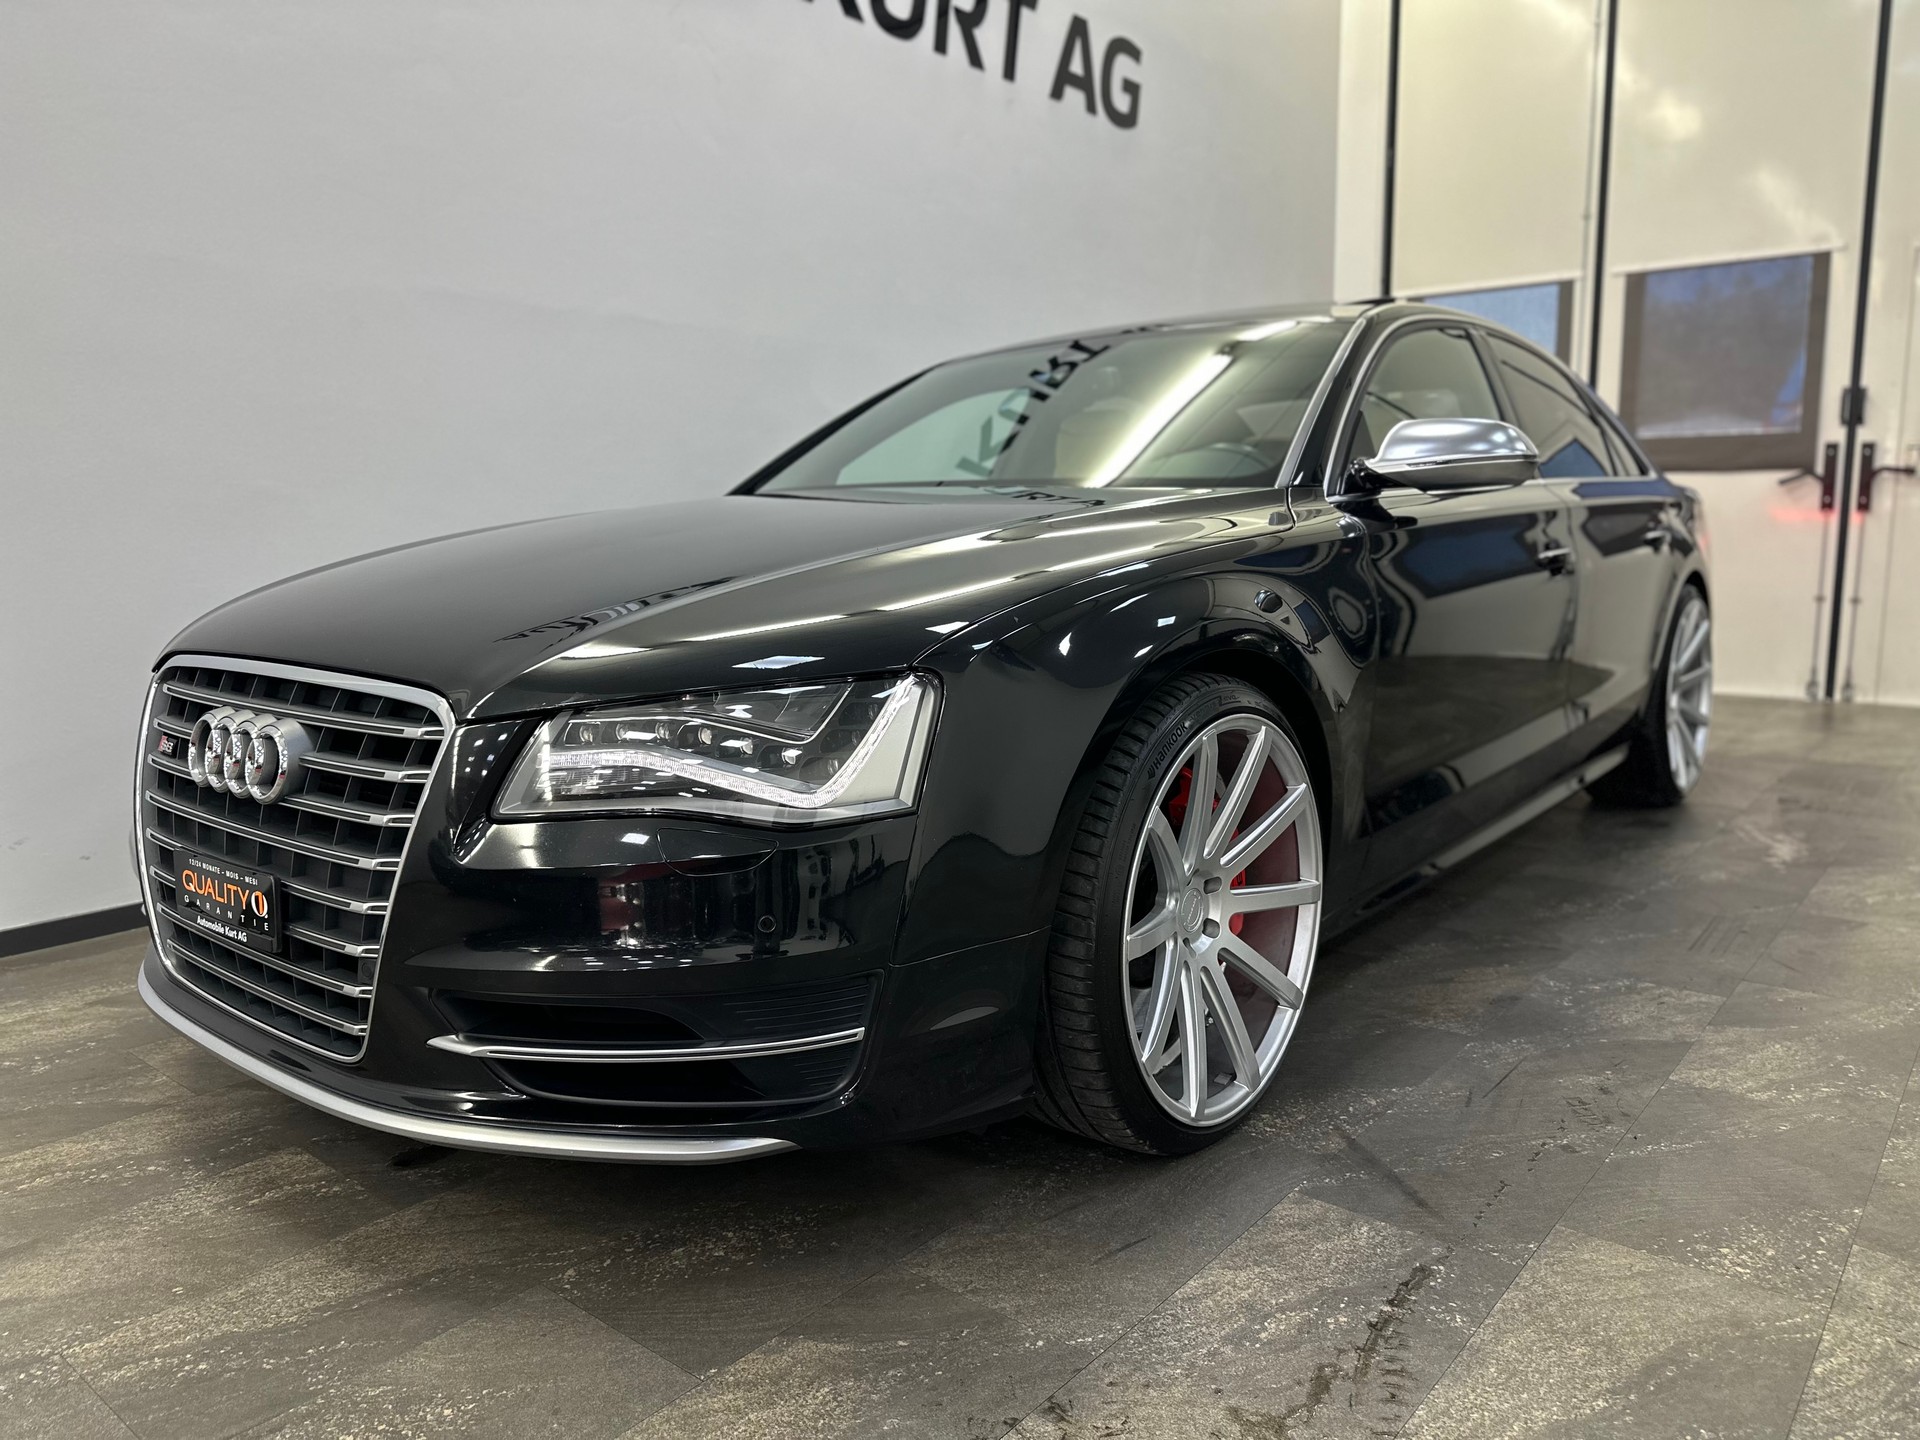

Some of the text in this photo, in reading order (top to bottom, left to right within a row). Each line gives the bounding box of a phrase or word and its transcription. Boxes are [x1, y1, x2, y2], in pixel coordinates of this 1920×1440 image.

[805, 0, 1142, 131] RT AG
[182, 869, 250, 910] QUALITY
[202, 862, 221, 875] MONATE
[225, 870, 239, 880] MOIS
[244, 876, 258, 886] MESI
[184, 894, 269, 931] GARANTIE
[197, 915, 248, 943] Automobile Kurt AG
